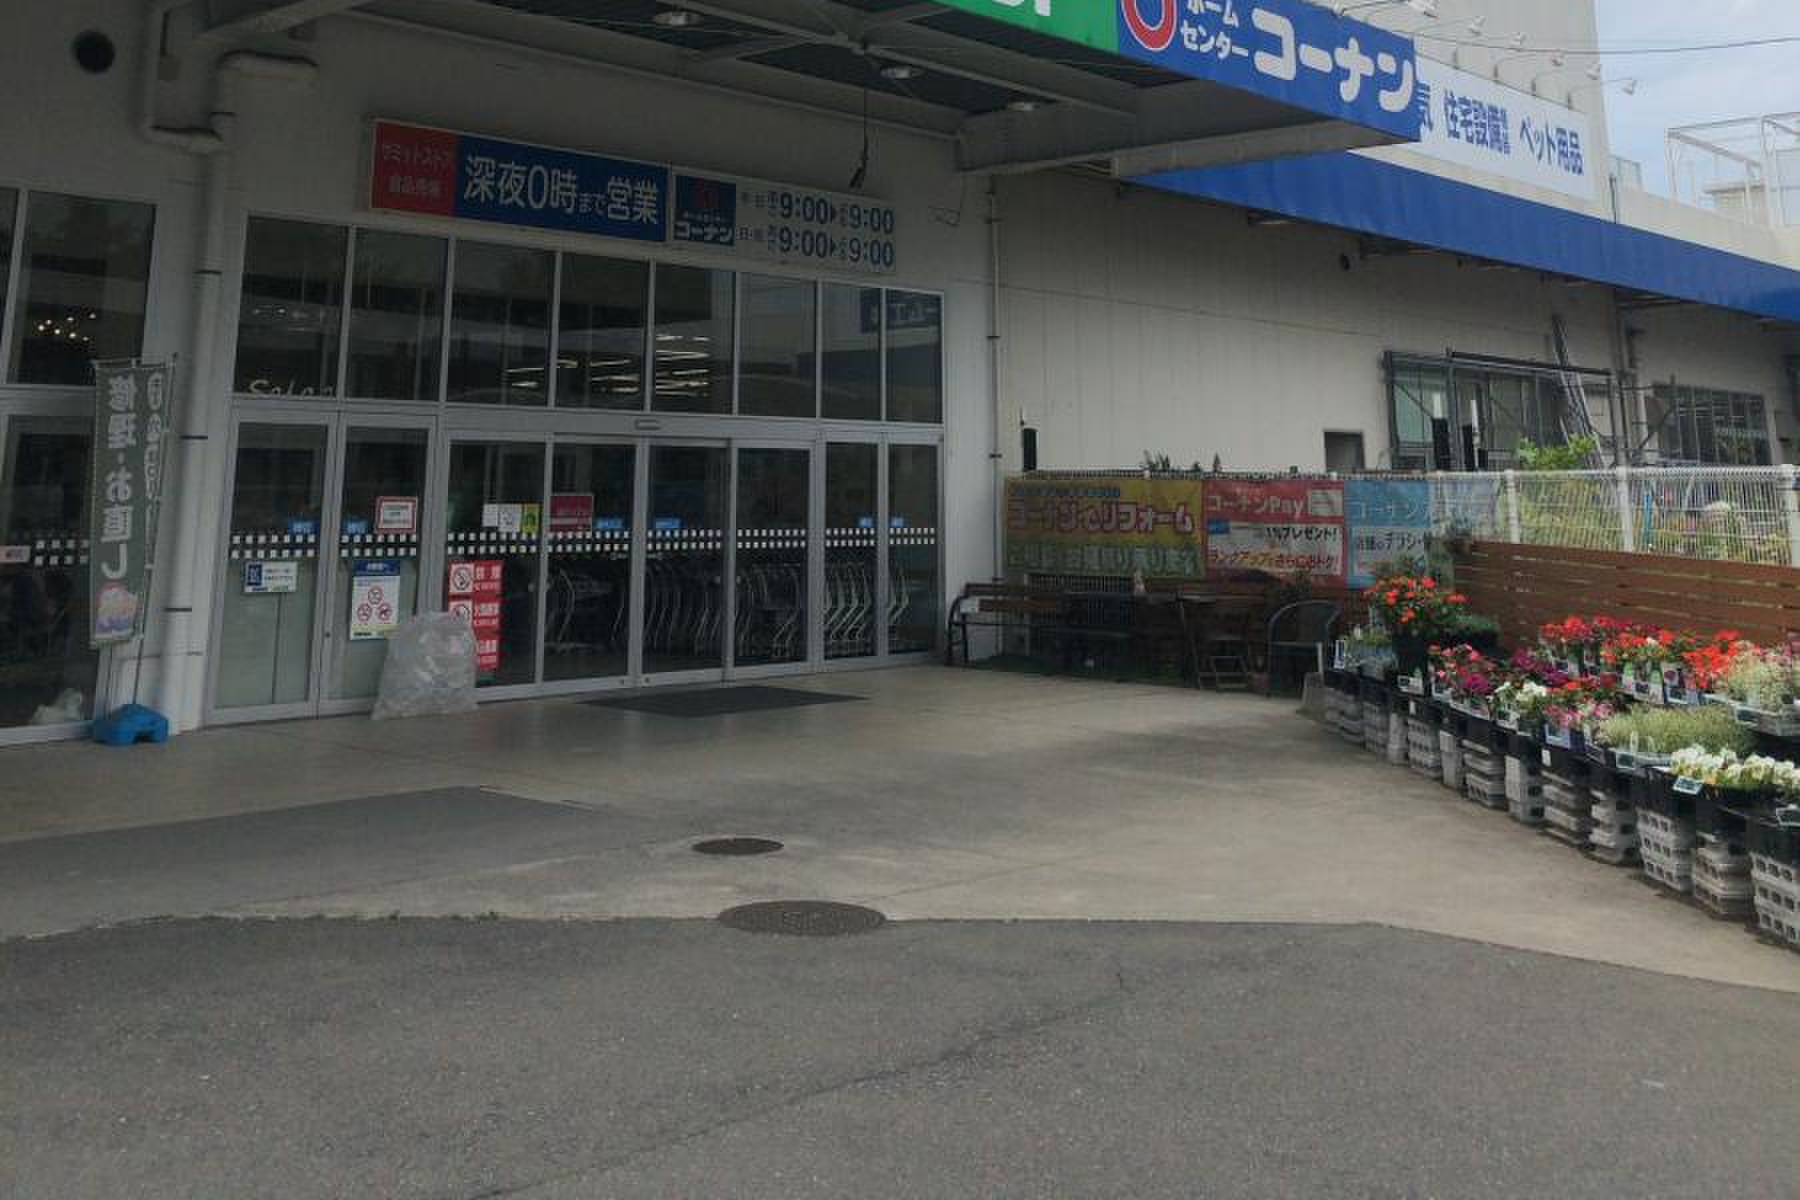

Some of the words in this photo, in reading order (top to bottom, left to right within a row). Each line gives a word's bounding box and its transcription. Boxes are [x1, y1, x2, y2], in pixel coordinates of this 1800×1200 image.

[1180, 19, 1249, 60] センター
[1251, 7, 1414, 113] コーナン
[1519, 116, 1585, 176] ペット用品
[779, 192, 829, 225] 9:00
[849, 204, 895, 235] 9:00
[778, 226, 828, 258] 9:00
[848, 237, 895, 268] 9:00
